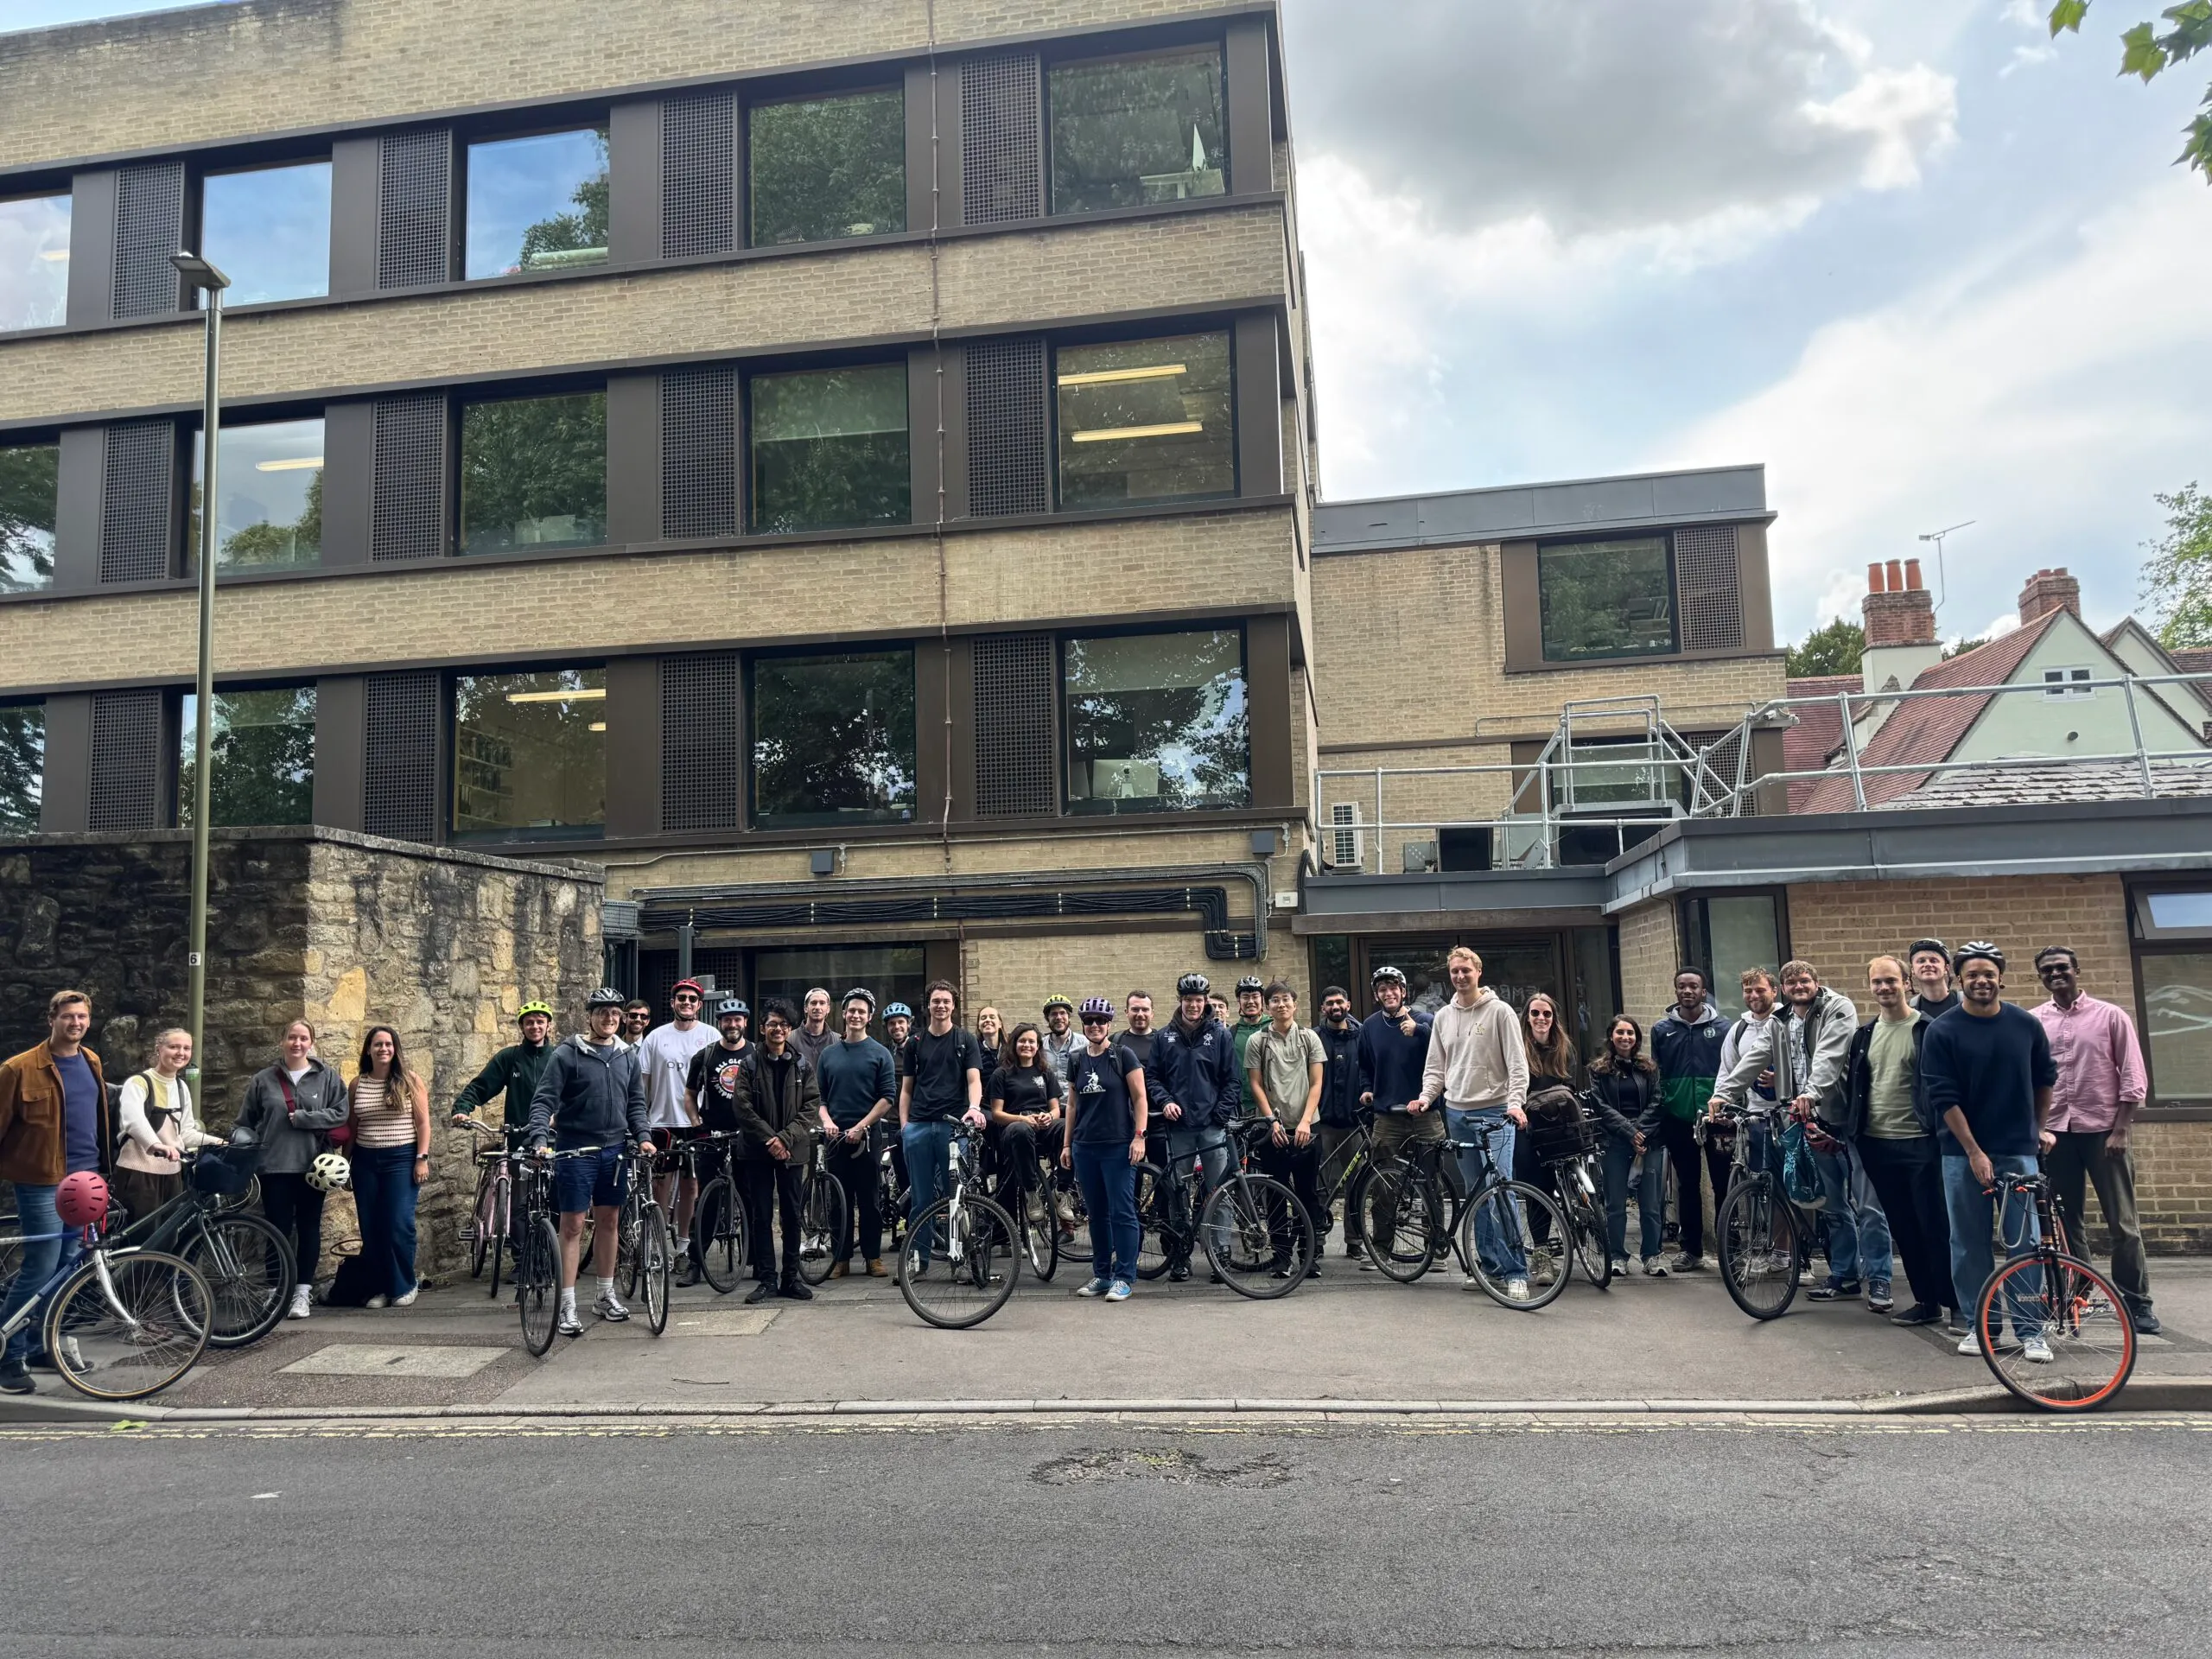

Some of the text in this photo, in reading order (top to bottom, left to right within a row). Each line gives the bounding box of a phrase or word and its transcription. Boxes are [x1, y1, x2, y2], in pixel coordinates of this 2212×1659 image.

[190, 954, 197, 964] 6
[715, 1061, 728, 1073] ALL
[715, 1084, 734, 1099] HYPN
[1337, 1150, 1362, 1188] TREK
